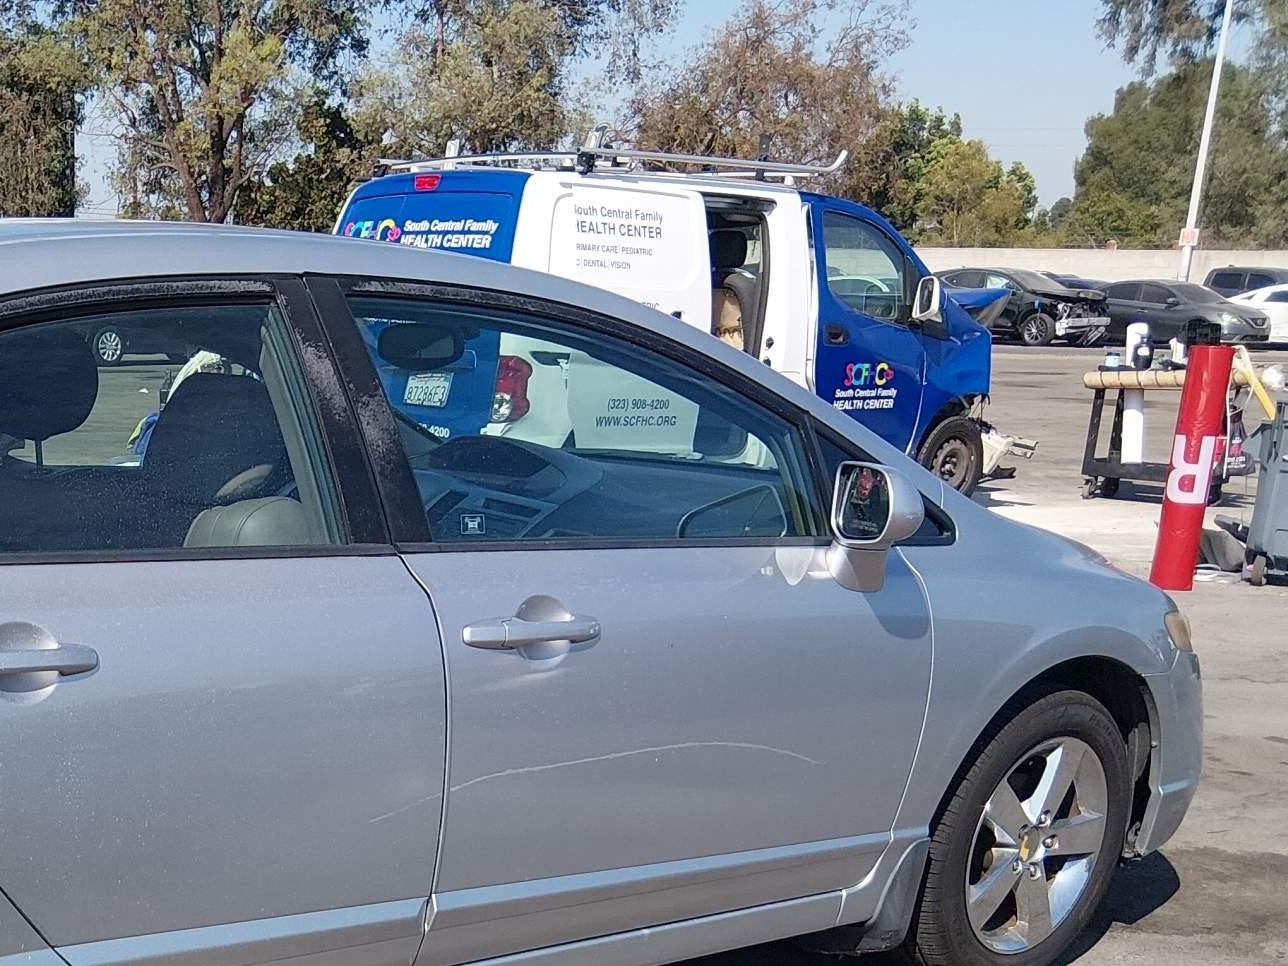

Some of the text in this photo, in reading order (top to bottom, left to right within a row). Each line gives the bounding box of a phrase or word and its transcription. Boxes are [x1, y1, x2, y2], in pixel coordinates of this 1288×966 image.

[574, 203, 663, 226] outh Central Family
[403, 219, 499, 234] South Central Family
[618, 223, 663, 239] CENTER
[400, 234, 493, 249] HEALTH CENTER
[575, 243, 600, 252] RIMARY
[621, 246, 653, 256] PEDIATRIC
[834, 387, 898, 399] South Central Family
[607, 398, 670, 412] (323) 908-4200
[833, 398, 894, 410] HEALTH CENTER
[595, 415, 677, 428] WWW.SCFHC.ORG
[1166, 434, 1216, 505] R
